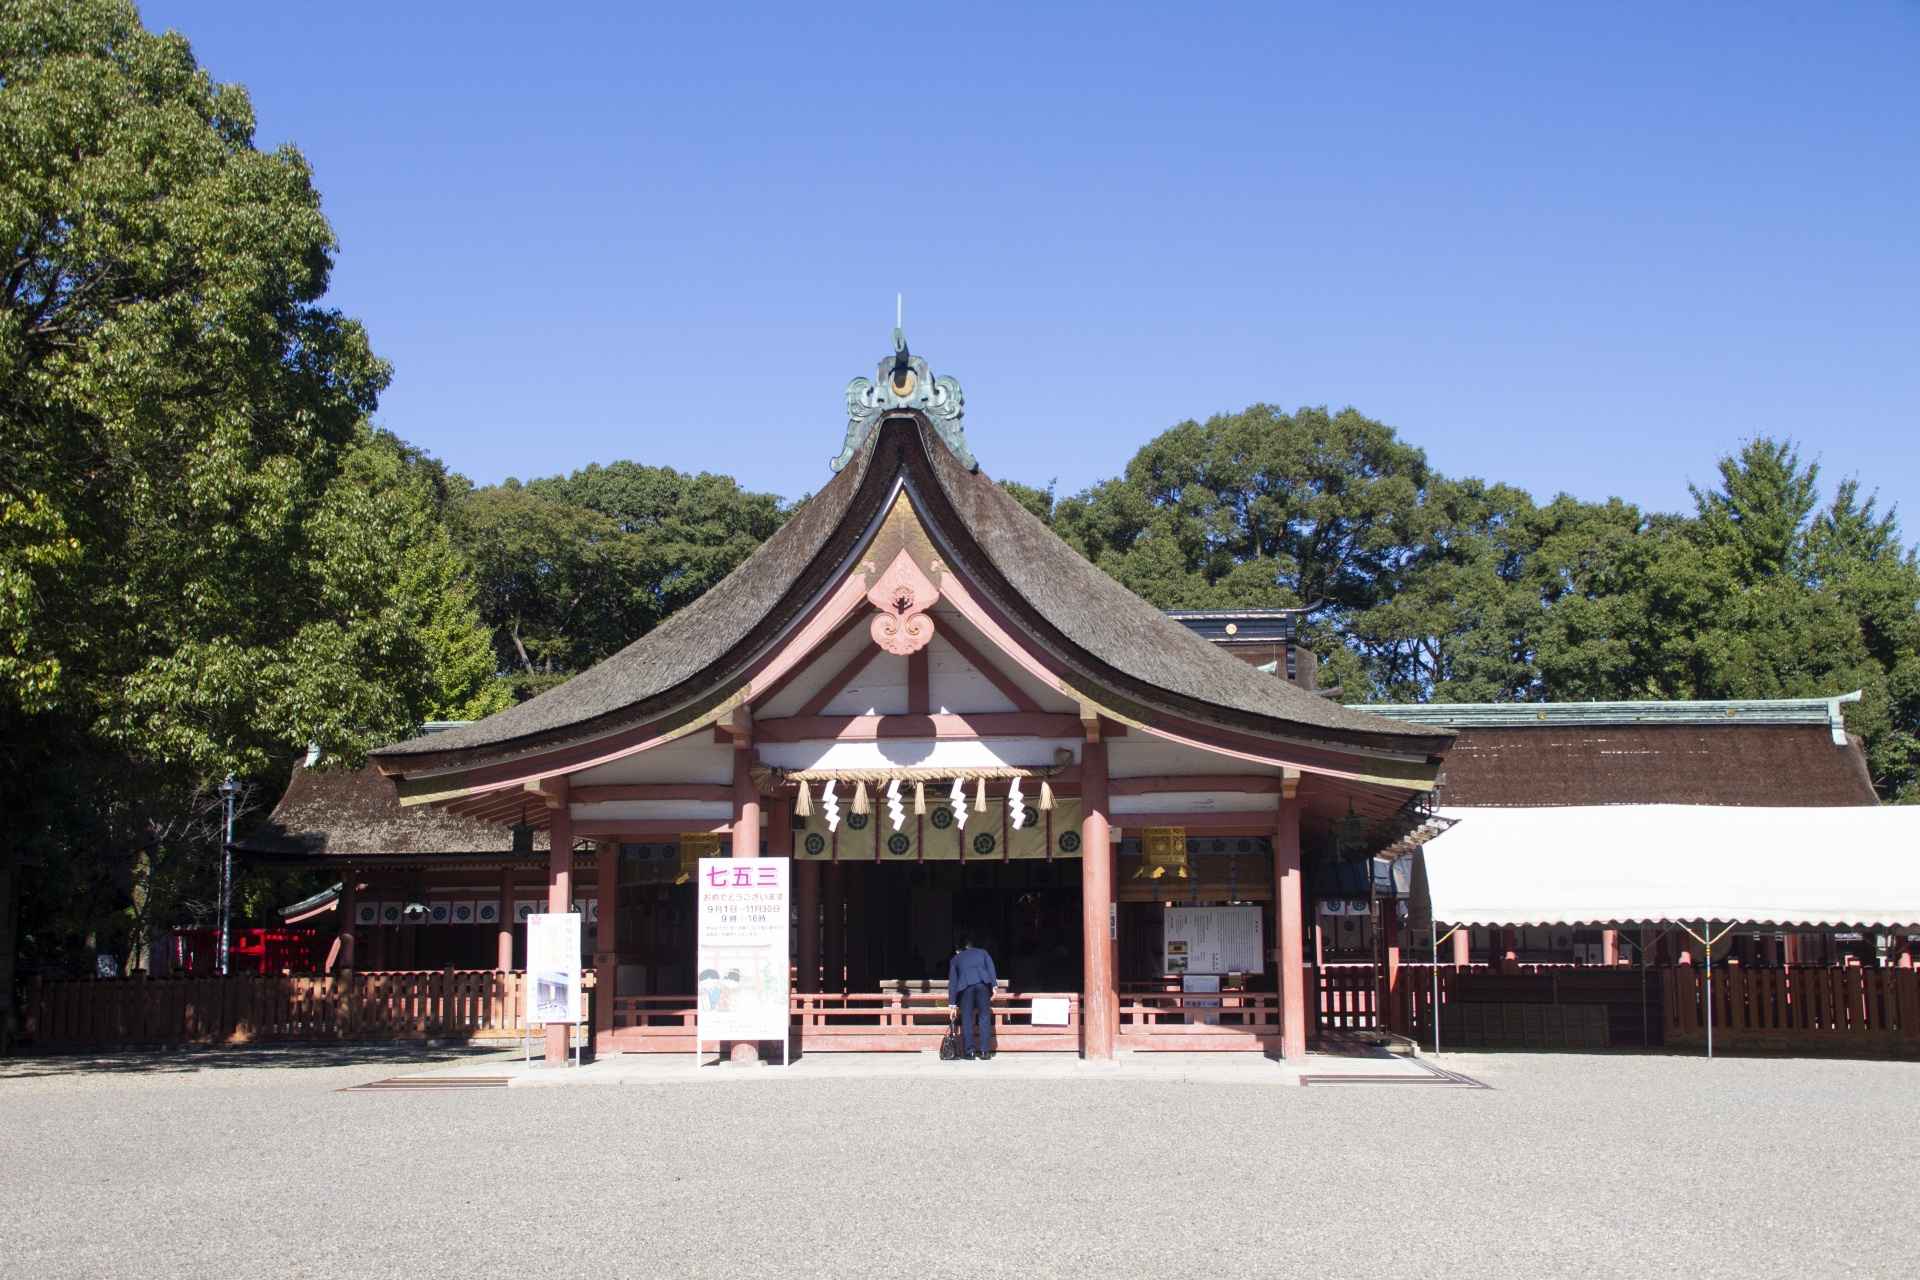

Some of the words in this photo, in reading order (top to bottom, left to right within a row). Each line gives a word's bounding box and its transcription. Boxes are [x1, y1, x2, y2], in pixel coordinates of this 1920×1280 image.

[706, 865, 778, 888] 七五三
[703, 893, 783, 902] おめでとうございます
